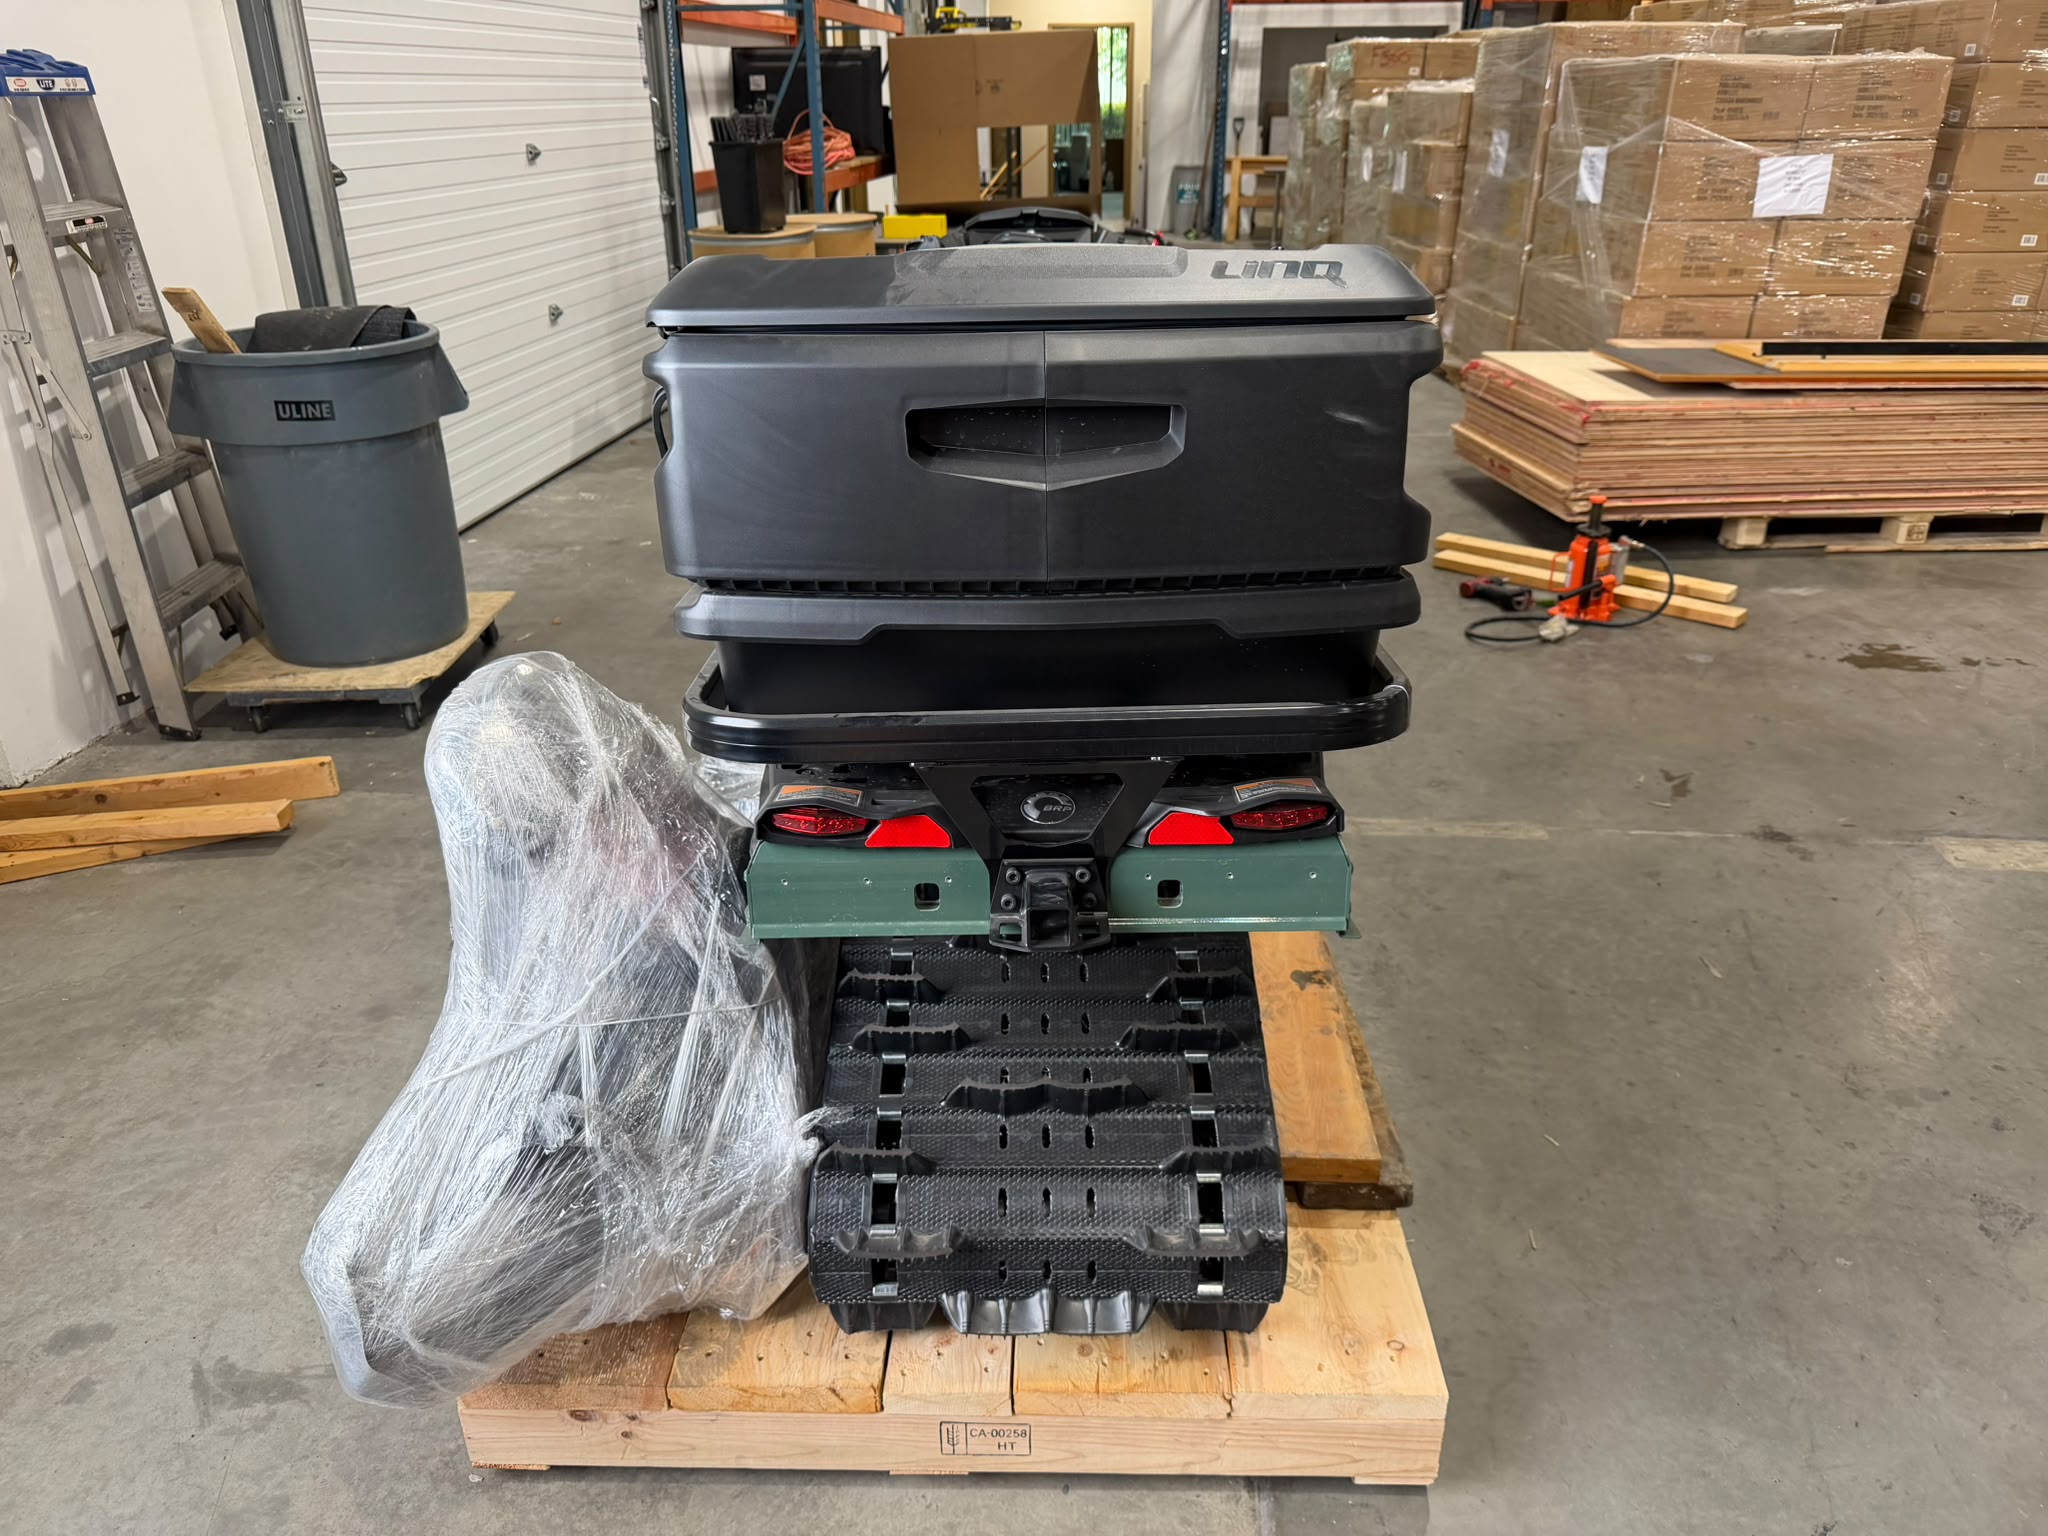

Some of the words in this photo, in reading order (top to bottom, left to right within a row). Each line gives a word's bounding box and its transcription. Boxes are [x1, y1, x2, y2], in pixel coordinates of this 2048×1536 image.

[39, 80, 54, 88] LITE
[277, 402, 332, 419] ULINE
[1042, 804, 1072, 812] BRP
[969, 1428, 1028, 1439] CA-00258
[997, 1441, 1017, 1451] HT
